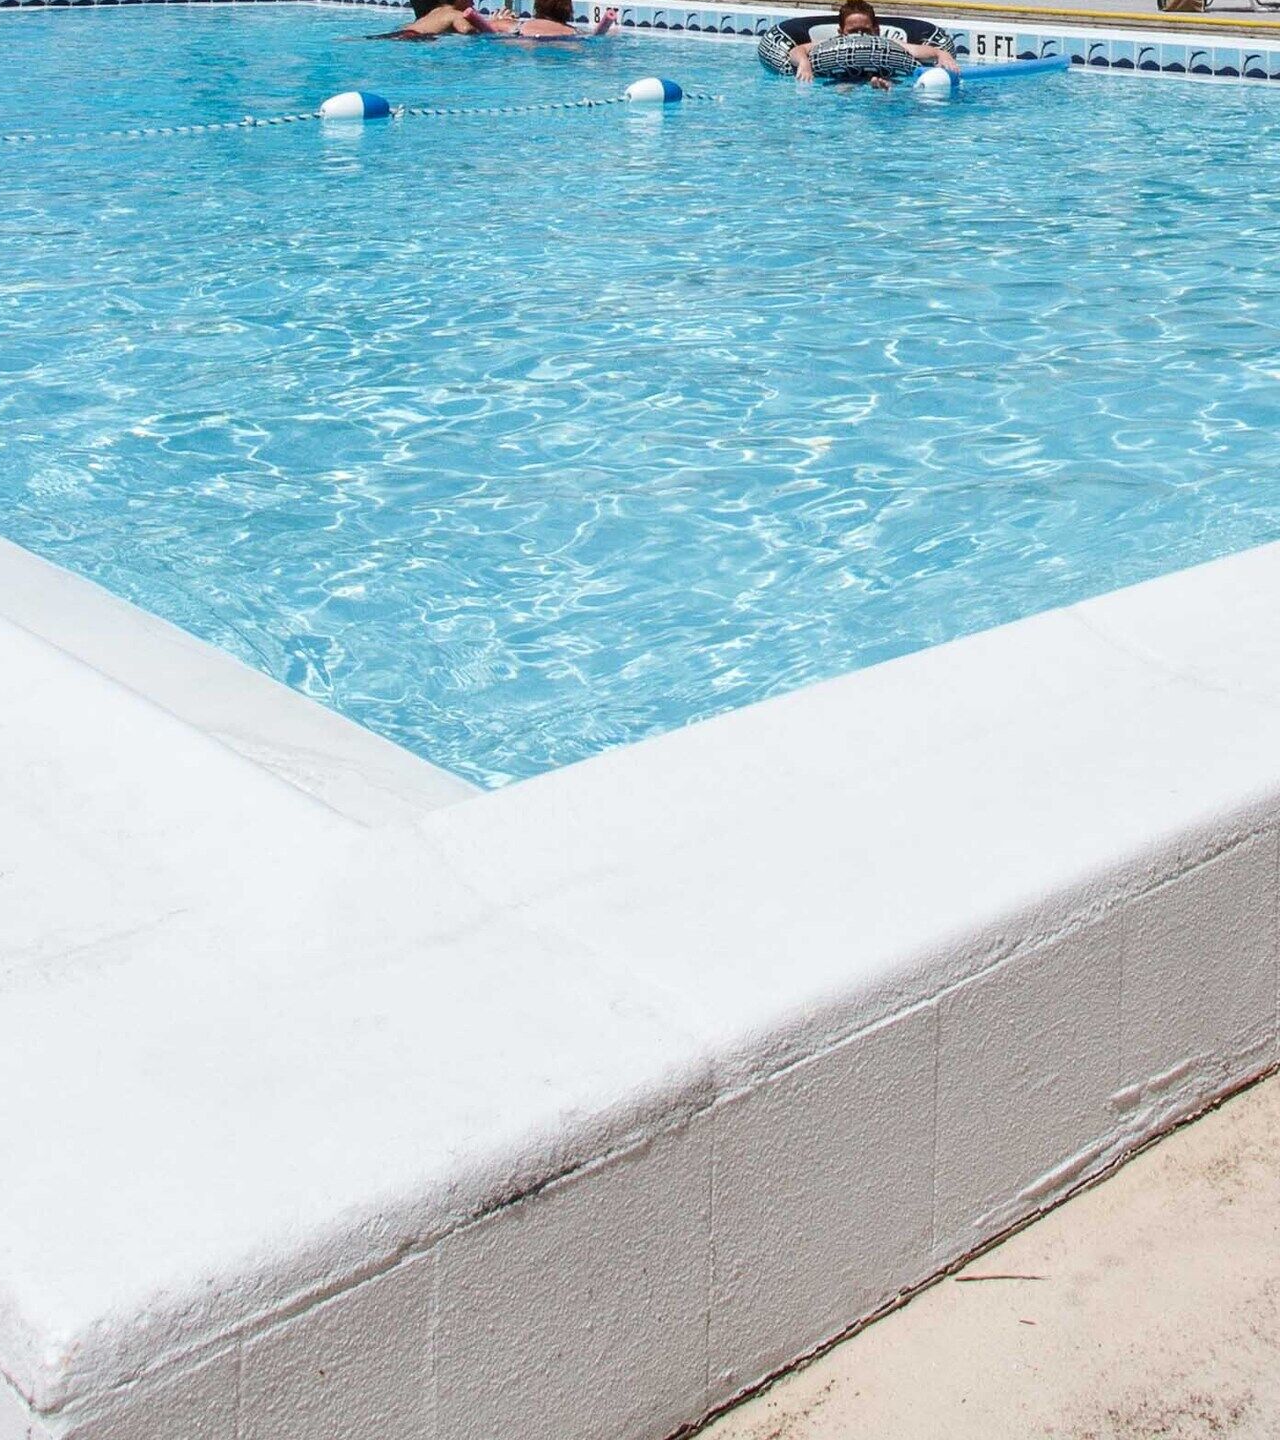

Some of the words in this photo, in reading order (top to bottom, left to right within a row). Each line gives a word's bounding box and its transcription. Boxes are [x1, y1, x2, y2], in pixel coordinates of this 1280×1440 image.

[594, 6, 600, 23] 8
[977, 34, 986, 55] 5
[995, 35, 1014, 58] FT.
